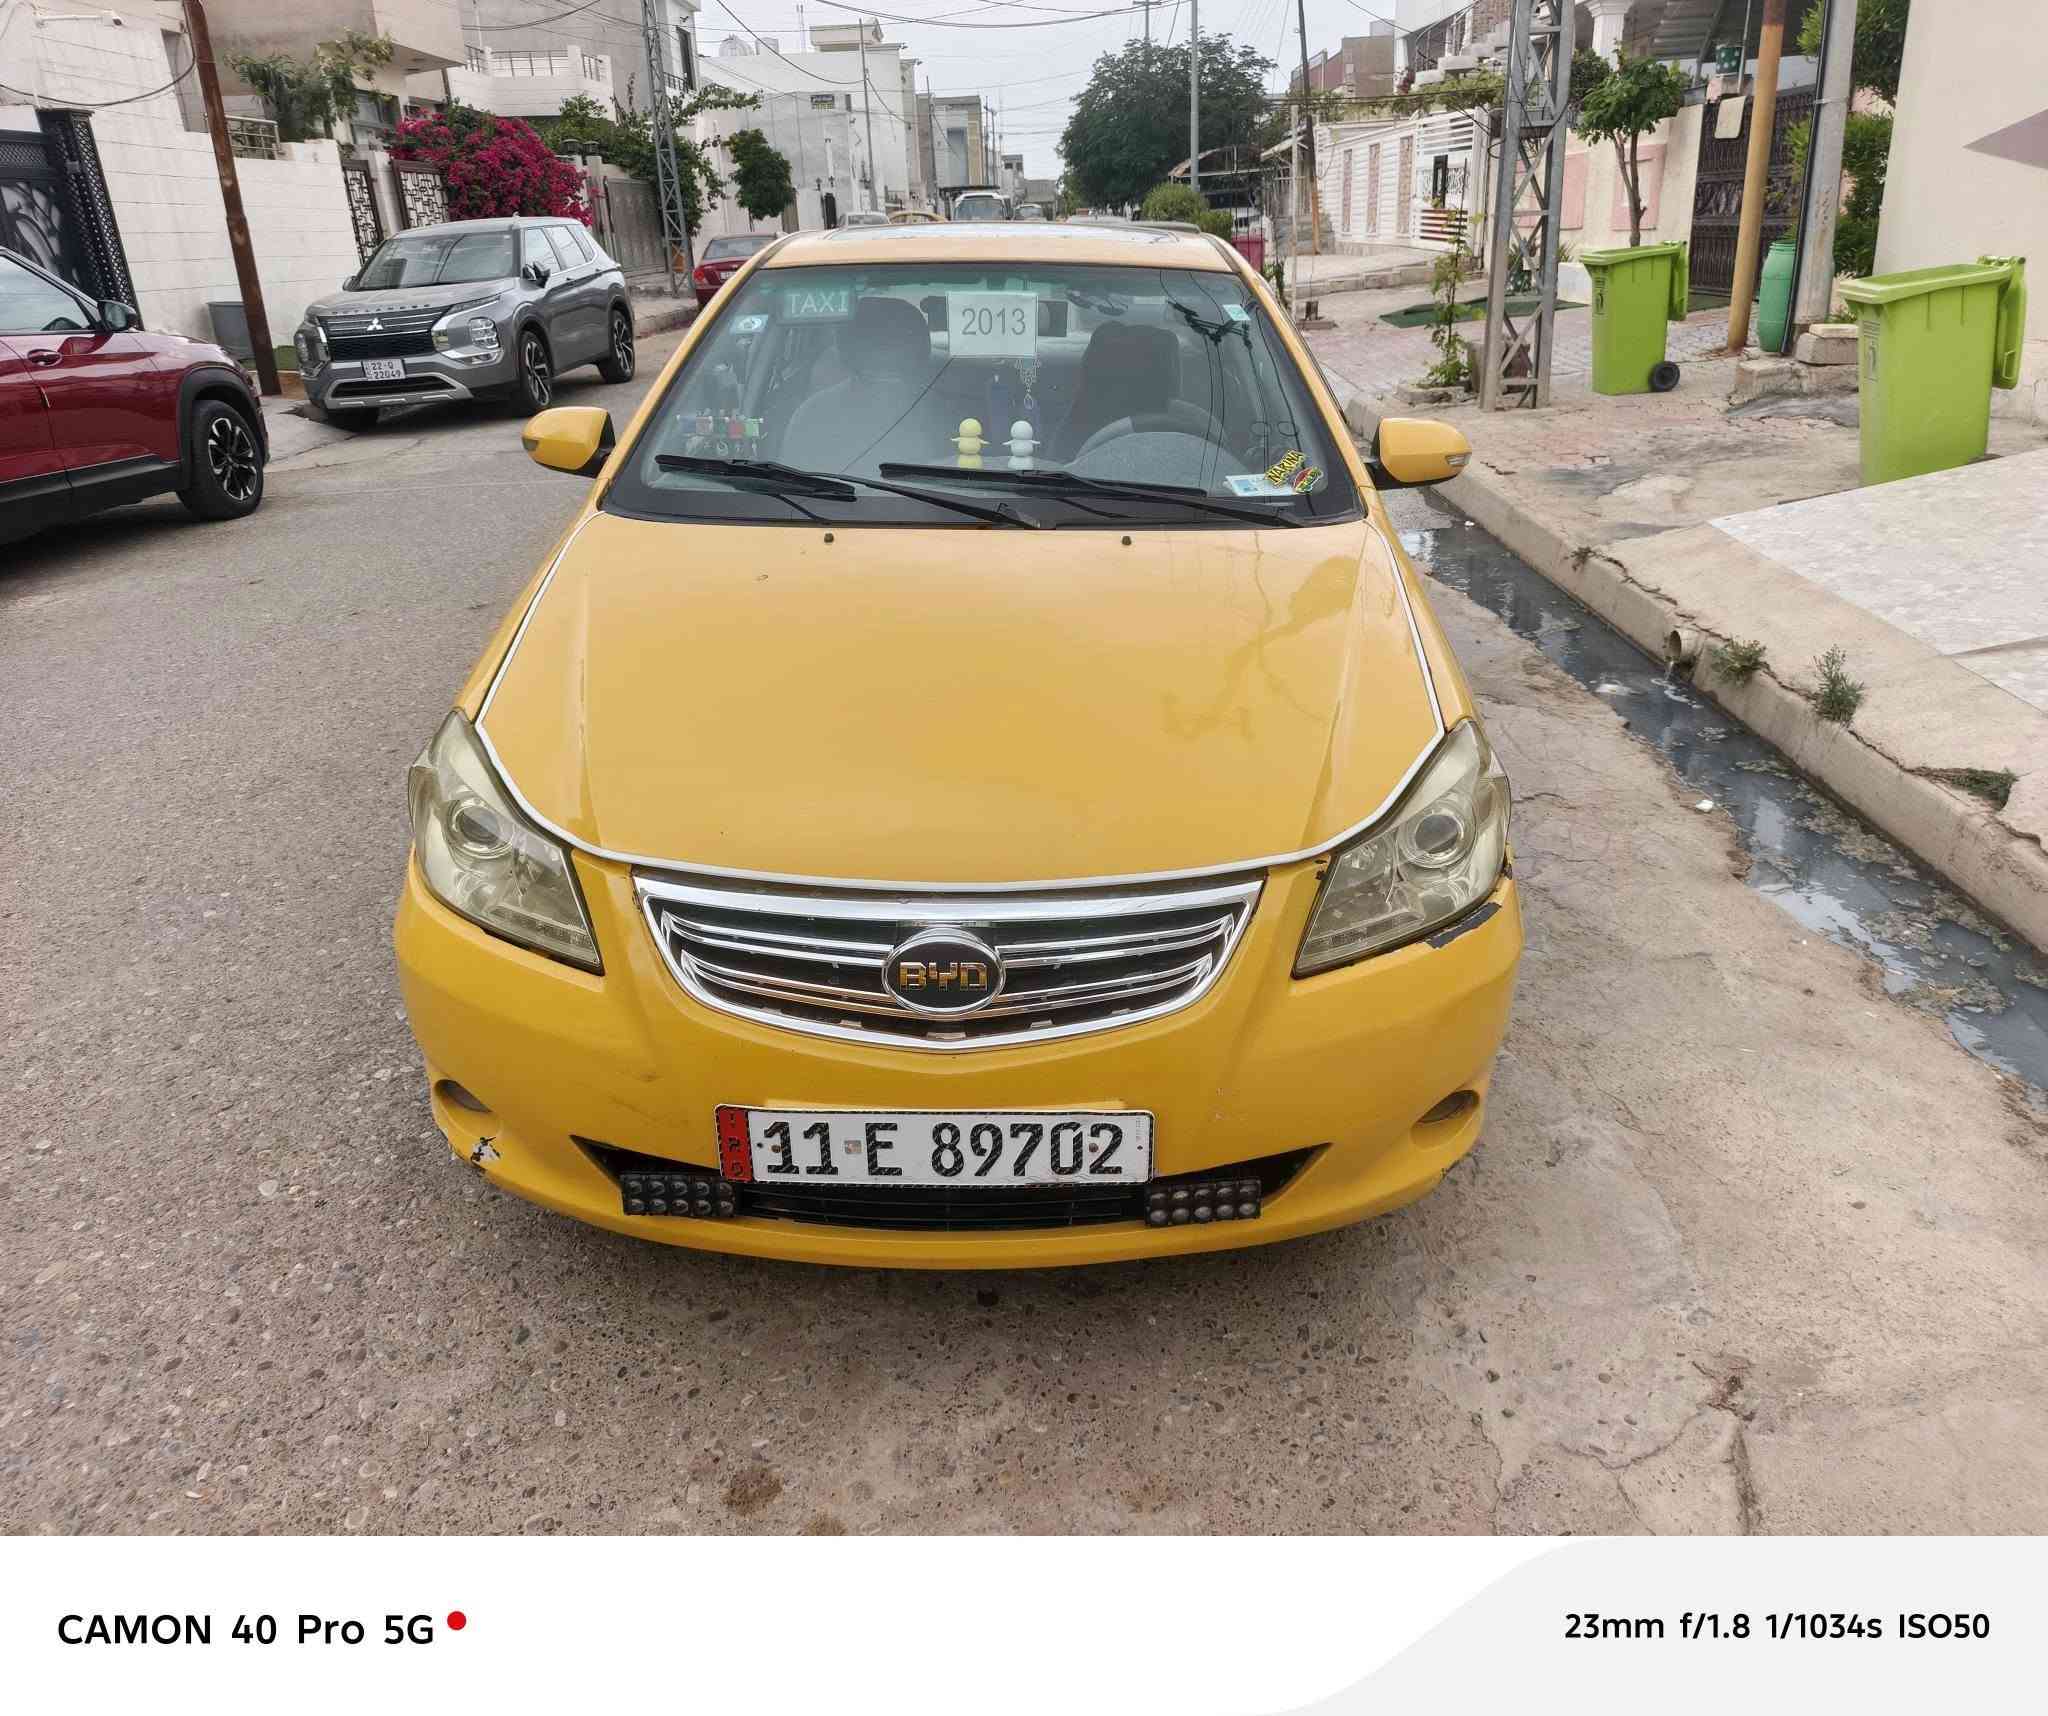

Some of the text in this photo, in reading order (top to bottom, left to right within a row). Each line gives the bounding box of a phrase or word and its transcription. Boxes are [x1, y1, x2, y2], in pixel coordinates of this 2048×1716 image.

[787, 290, 849, 314] TAXI
[962, 307, 1026, 336] 2013
[900, 961, 988, 991] BYD
[764, 1122, 1123, 1177] 11 E 89702
